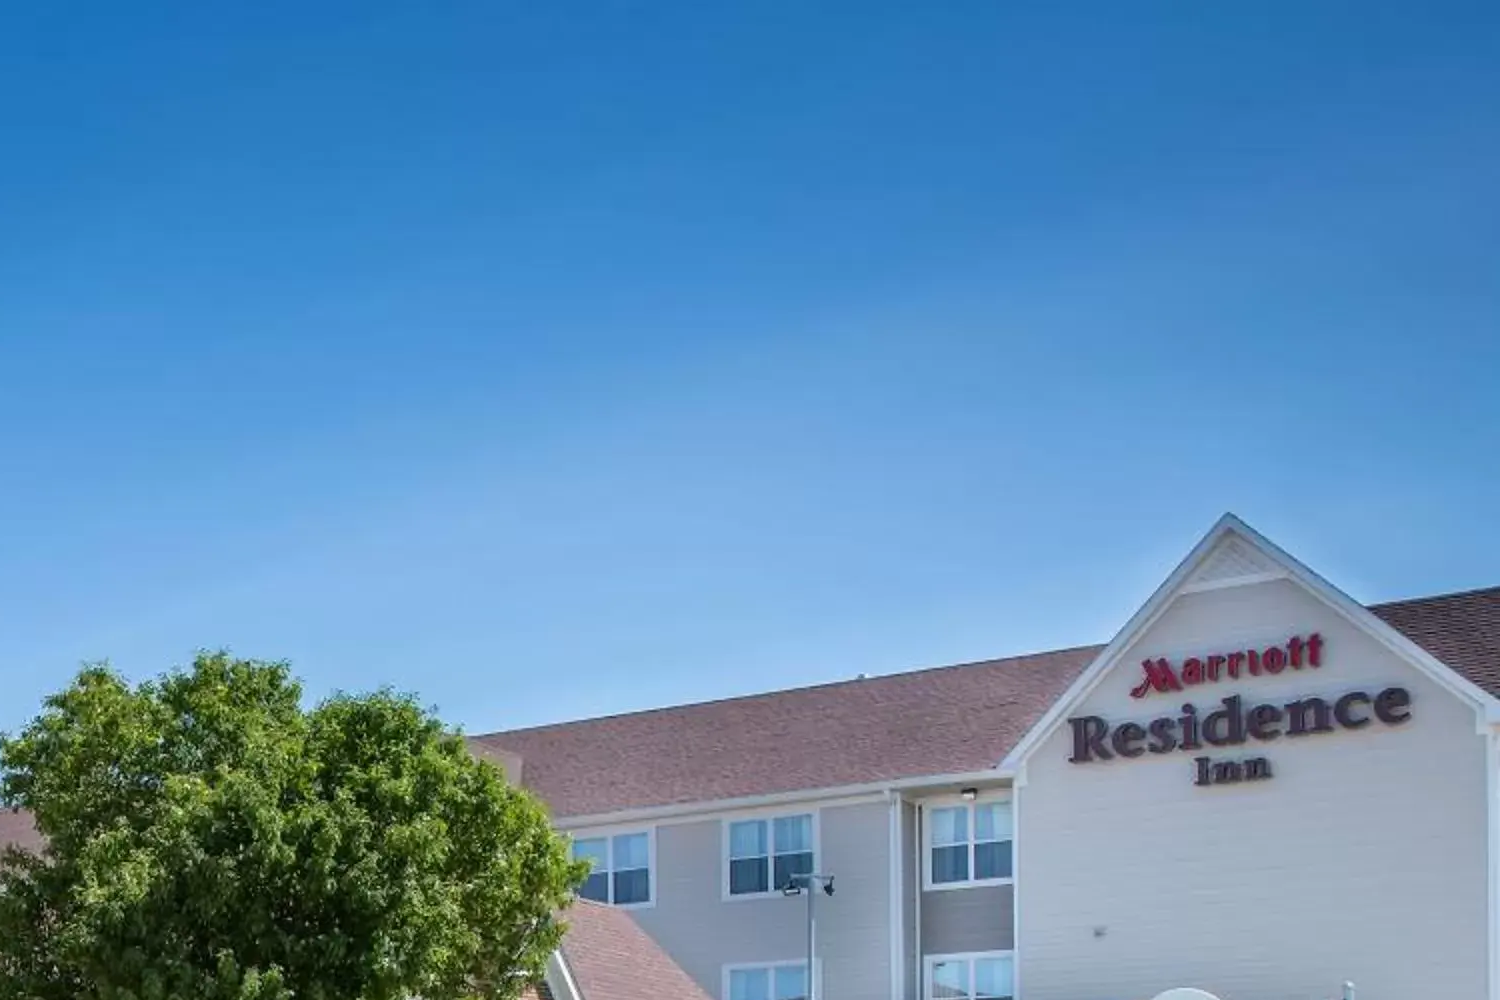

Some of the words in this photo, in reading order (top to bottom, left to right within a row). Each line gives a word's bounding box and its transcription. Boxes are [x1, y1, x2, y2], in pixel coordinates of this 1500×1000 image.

[1130, 632, 1324, 698] Marriott
[1067, 687, 1412, 764] Residence
[1194, 756, 1274, 786] Inn
